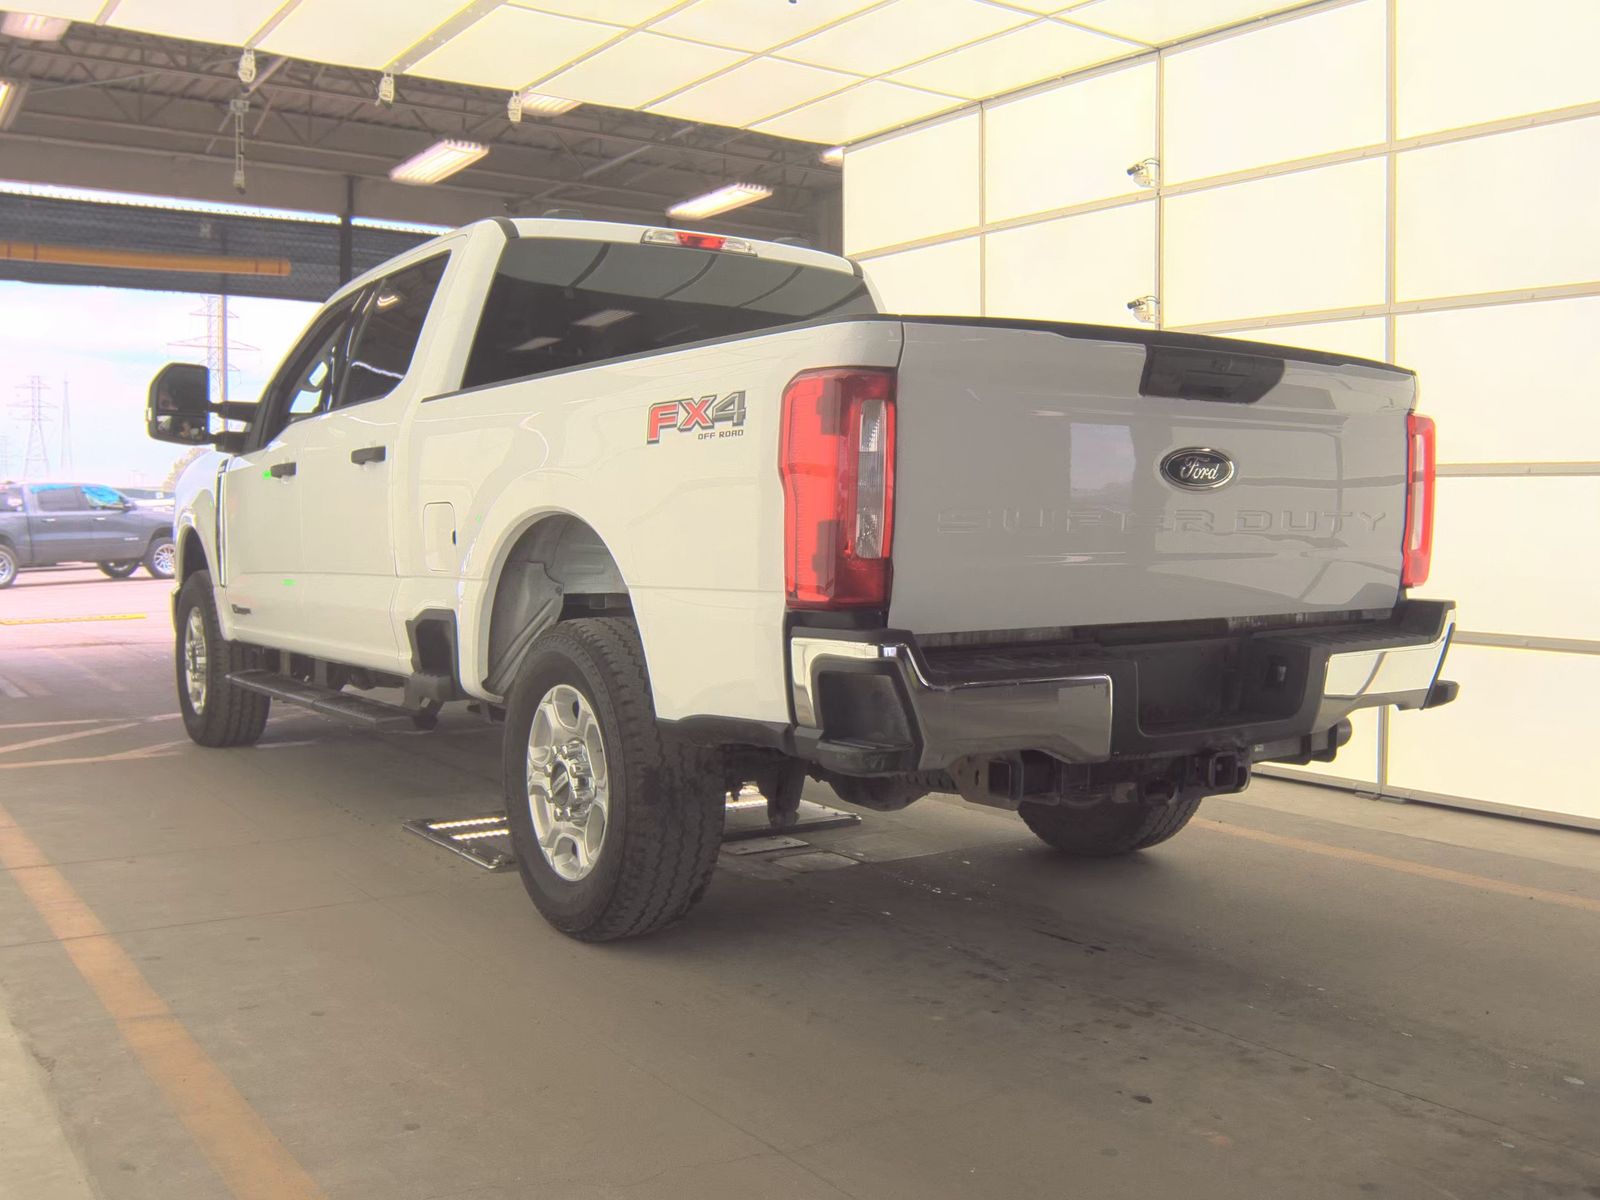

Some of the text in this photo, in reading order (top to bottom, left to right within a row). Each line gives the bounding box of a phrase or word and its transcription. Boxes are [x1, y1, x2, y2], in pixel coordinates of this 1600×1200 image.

[647, 390, 746, 444] FX4
[697, 429, 744, 440] OFF ROAD
[1180, 456, 1220, 480] Ford
[1235, 510, 1386, 534] DUTY
